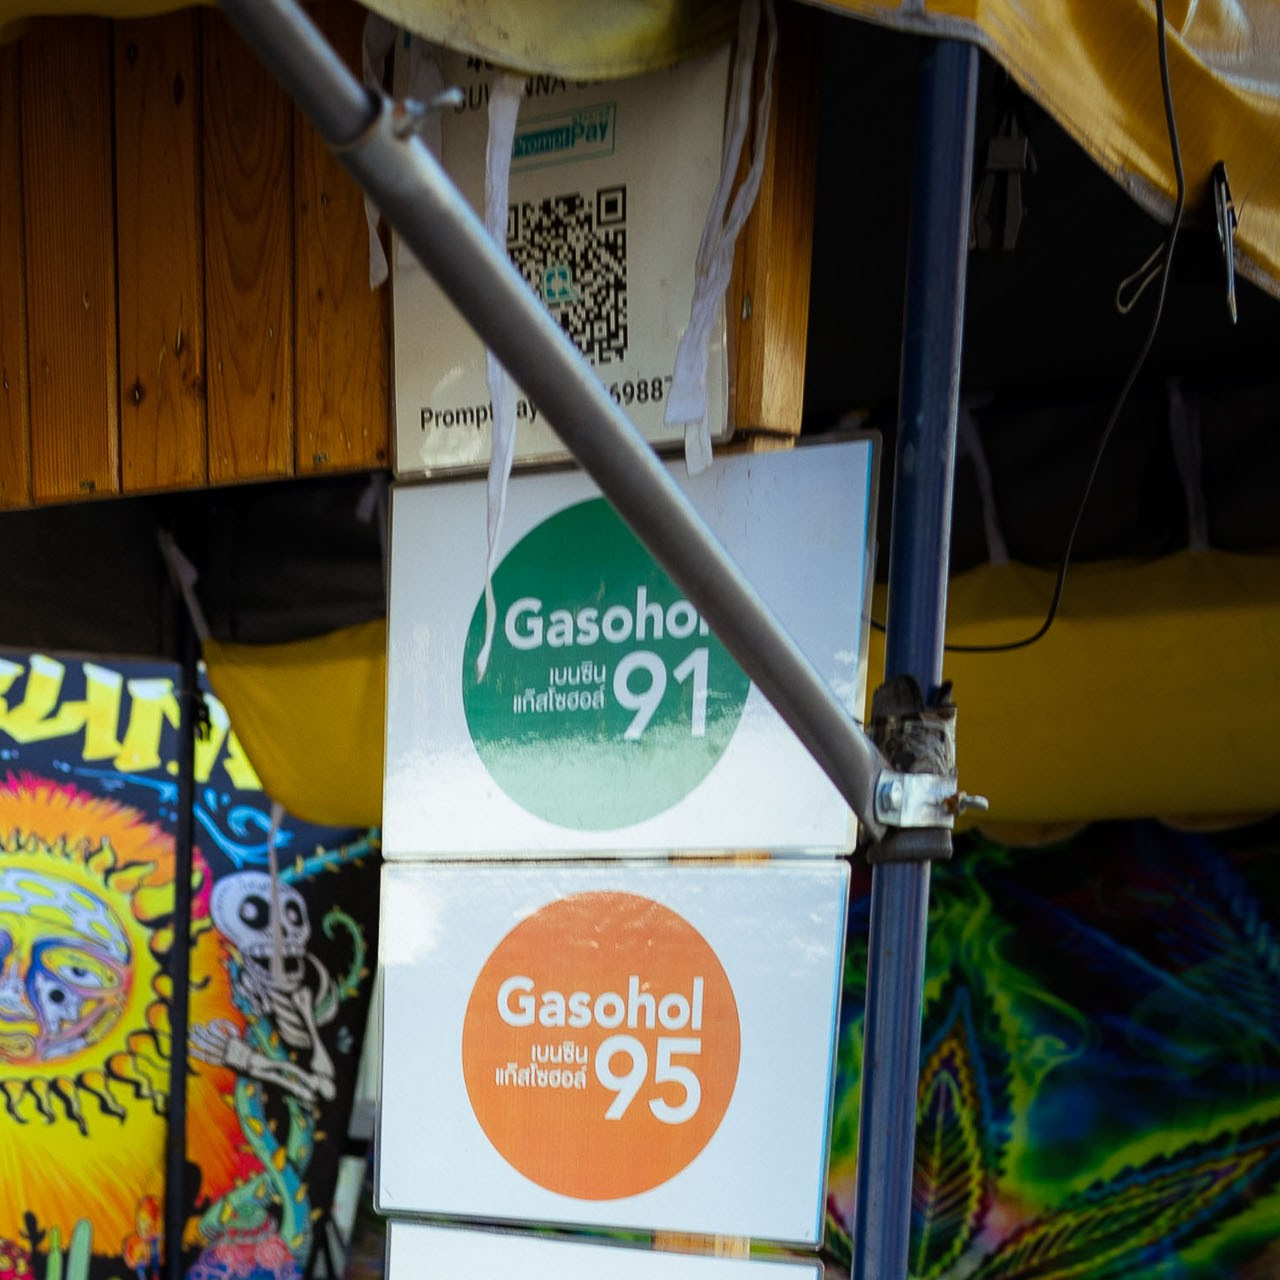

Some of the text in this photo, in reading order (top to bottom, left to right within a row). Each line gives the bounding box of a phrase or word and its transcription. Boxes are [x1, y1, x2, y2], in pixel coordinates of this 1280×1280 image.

[421, 398, 538, 431] Prompay
[613, 647, 710, 740] 91
[497, 975, 704, 1031] Gasohol
[594, 1034, 702, 1125] 95
